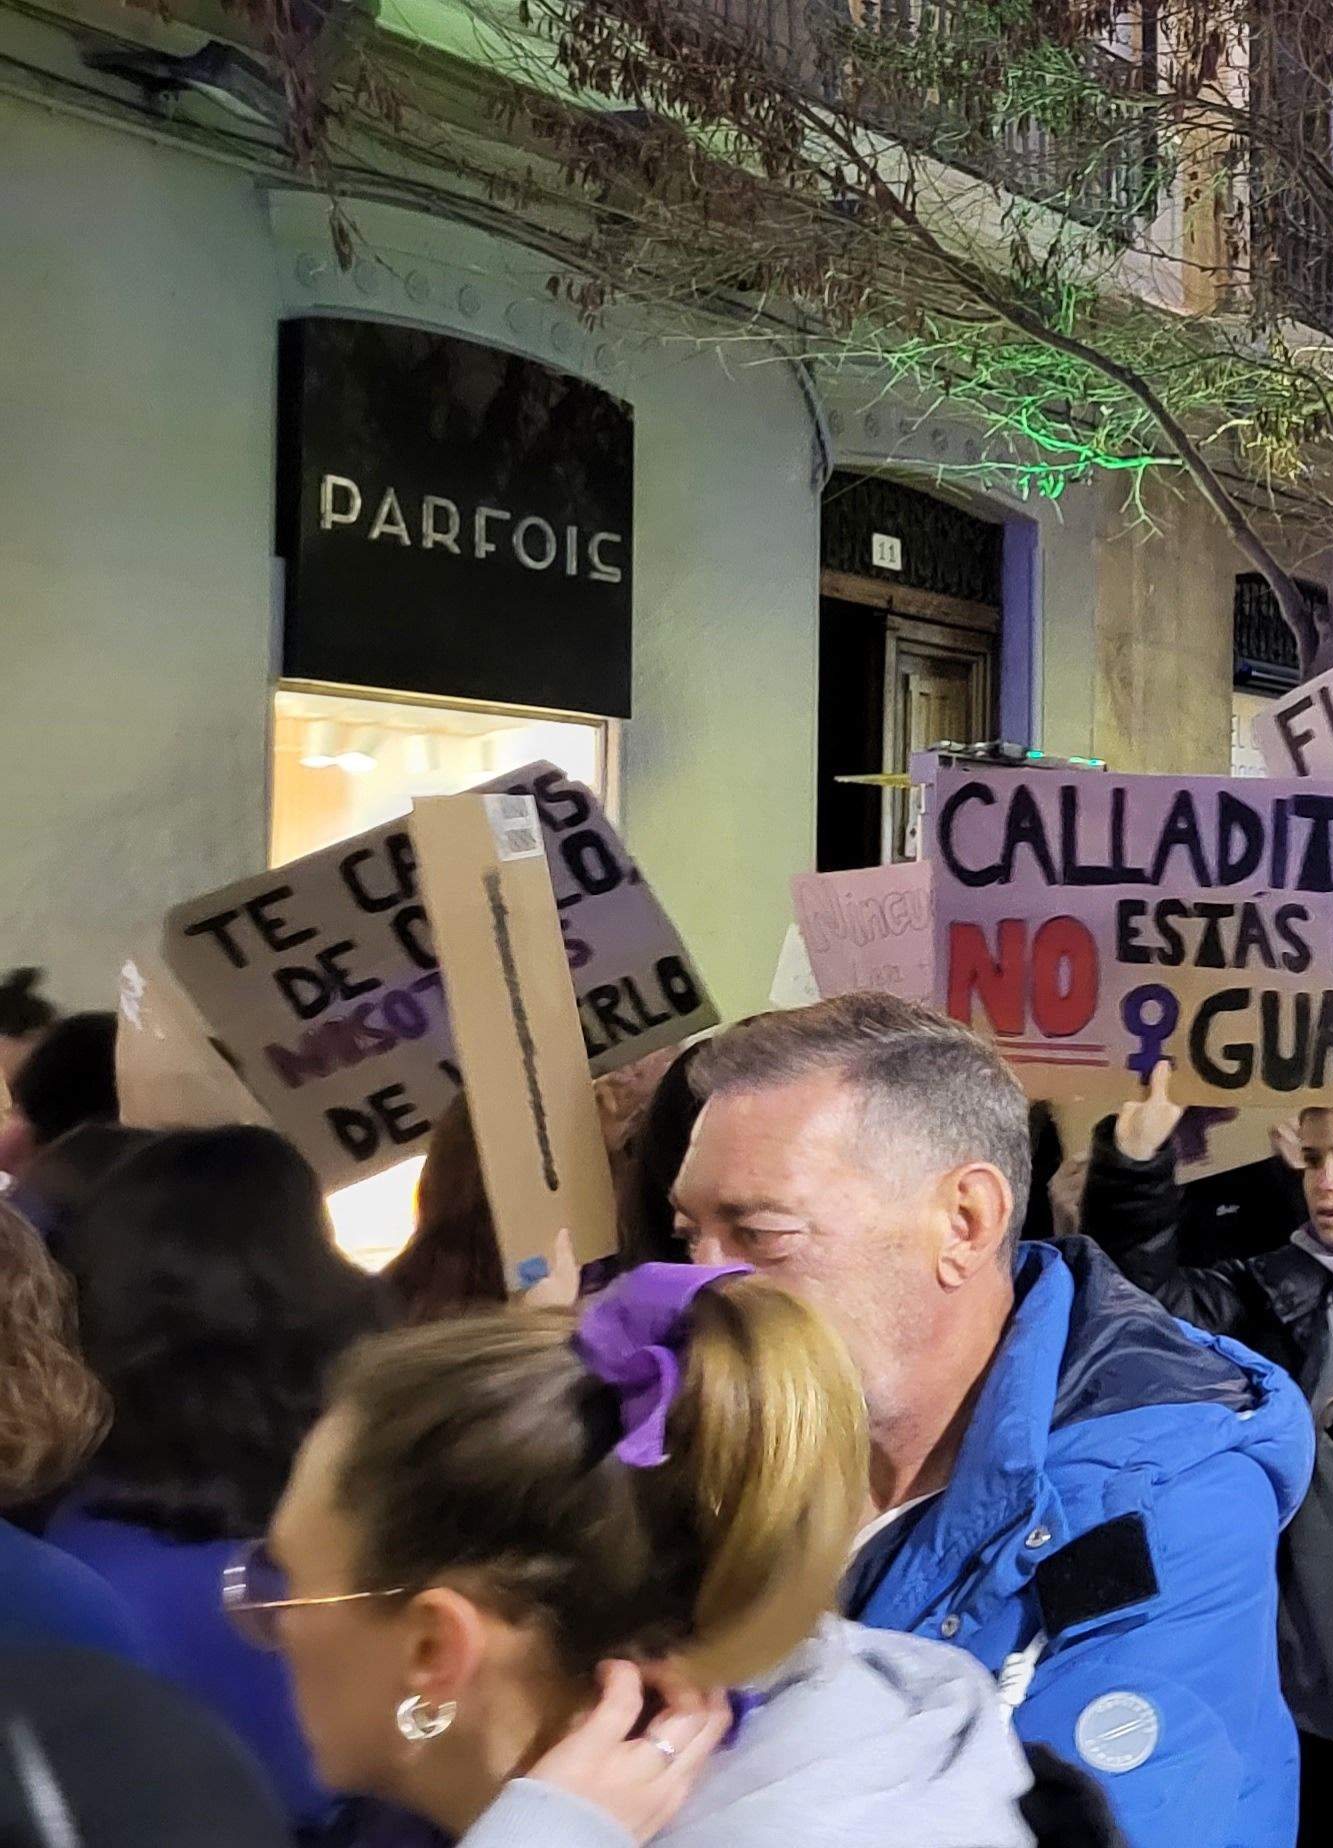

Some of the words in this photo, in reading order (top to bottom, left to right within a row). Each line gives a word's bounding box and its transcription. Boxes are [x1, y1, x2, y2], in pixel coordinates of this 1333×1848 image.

[320, 474, 622, 583] PARFOIS
[877, 541, 896, 564] 11
[184, 886, 319, 969] TE
[1116, 892, 1312, 972] ESTÁS
[273, 940, 383, 1020] DE
[946, 915, 1098, 1038] NO
[326, 1083, 432, 1162] DE
